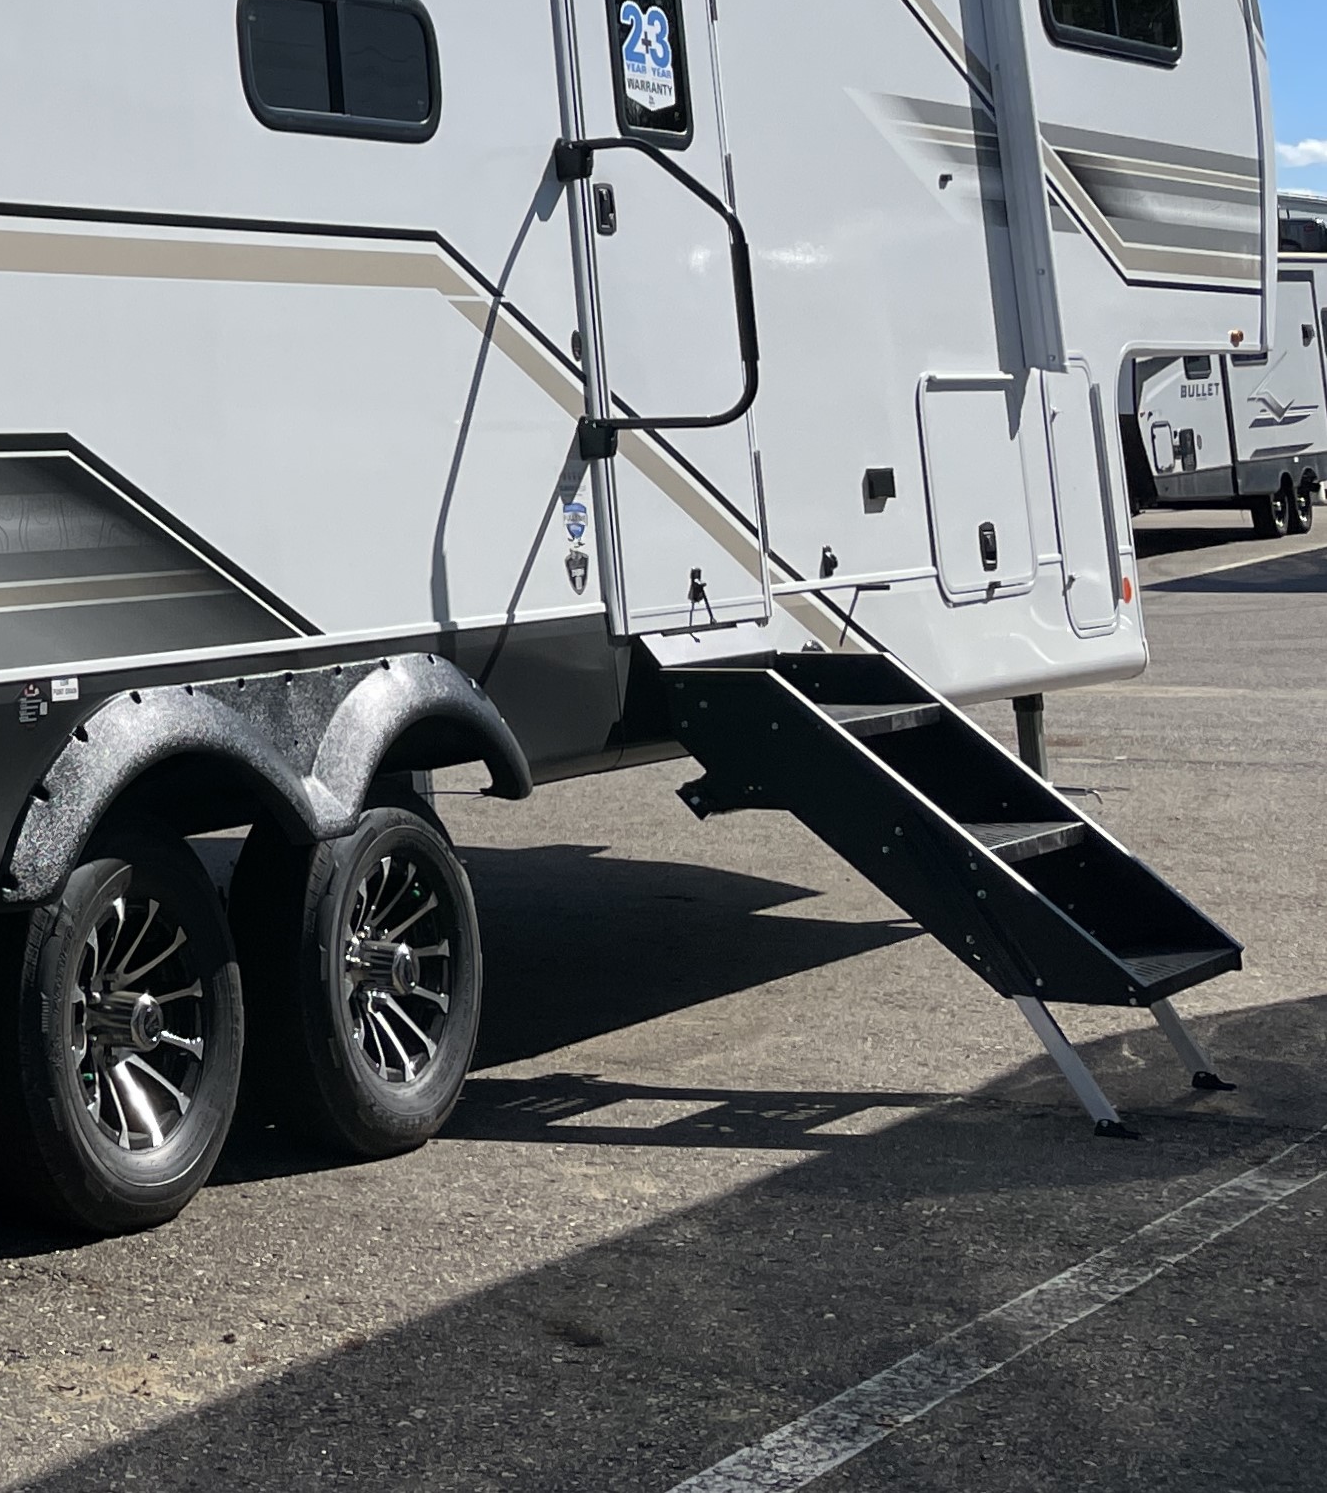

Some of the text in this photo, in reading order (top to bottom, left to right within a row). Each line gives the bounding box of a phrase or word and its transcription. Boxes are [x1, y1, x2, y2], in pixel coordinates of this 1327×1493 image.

[626, 62, 672, 80] YEAR YEAR
[627, 77, 673, 97] WARRANTY
[1180, 382, 1220, 399] BULLET
